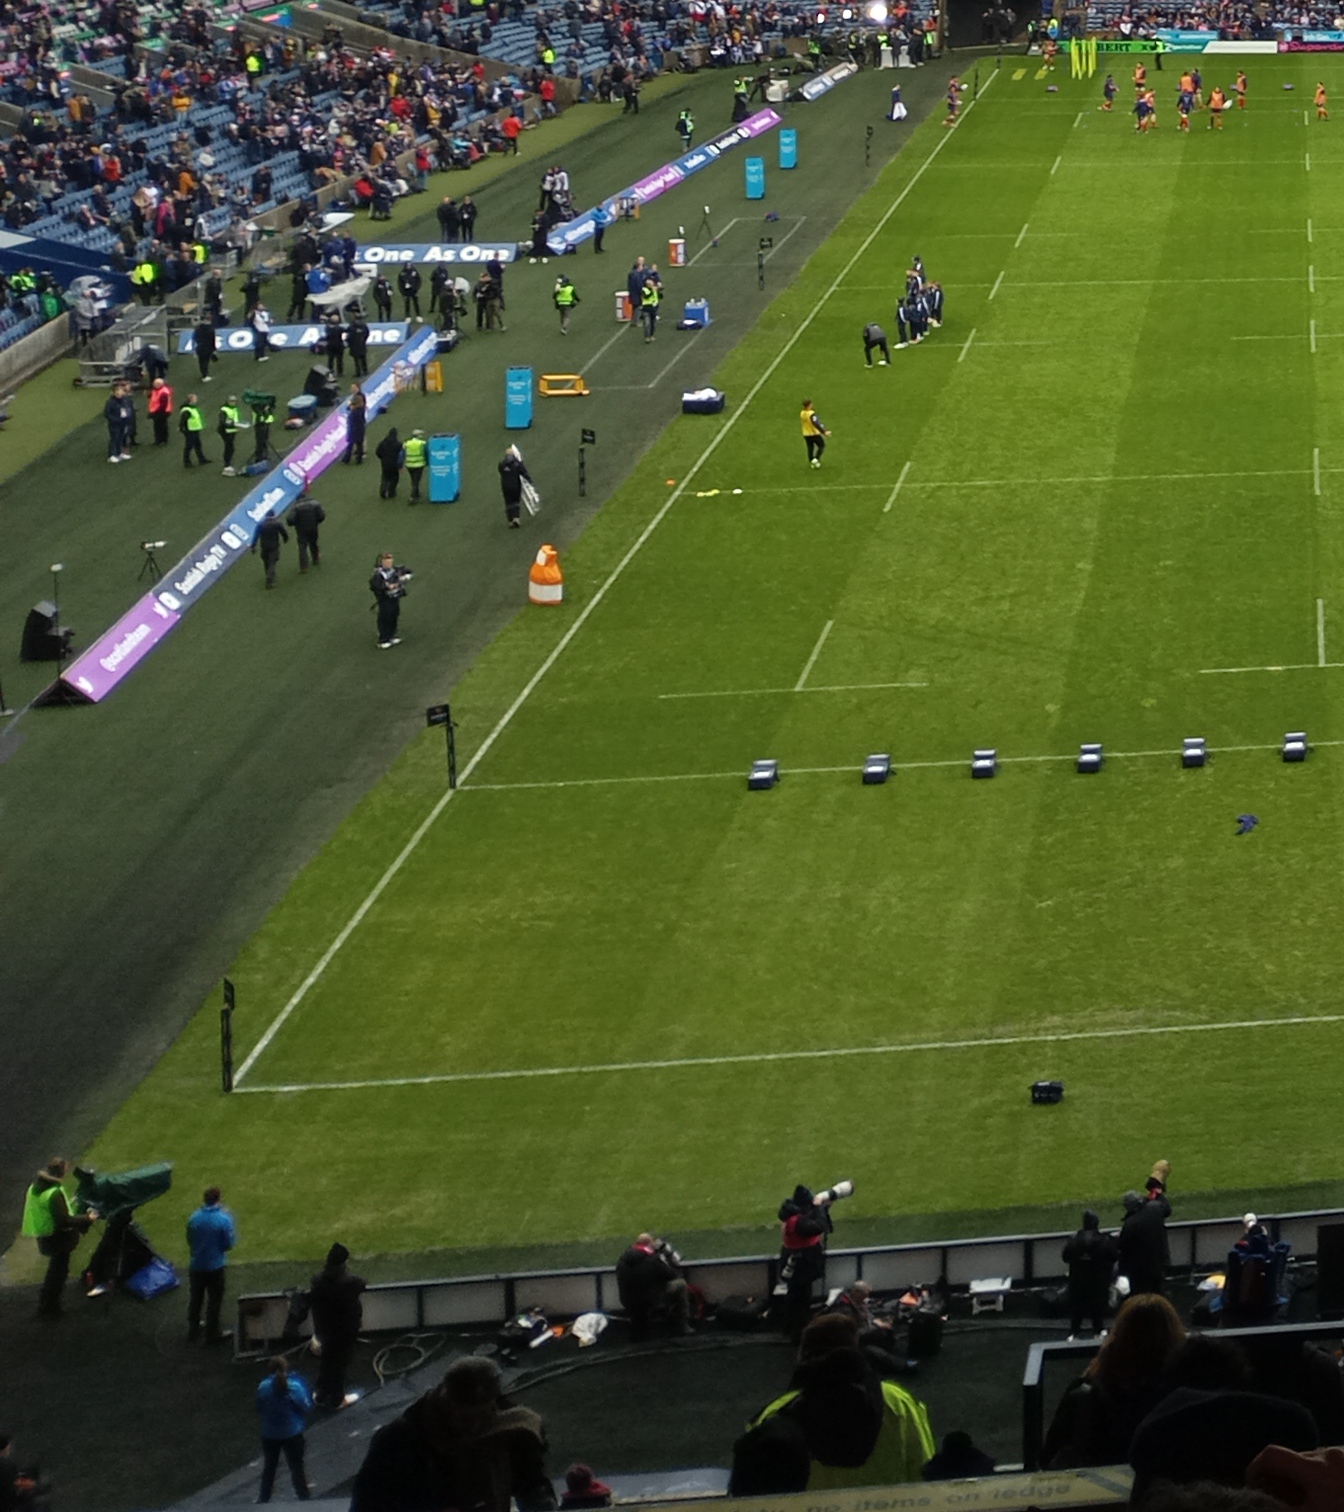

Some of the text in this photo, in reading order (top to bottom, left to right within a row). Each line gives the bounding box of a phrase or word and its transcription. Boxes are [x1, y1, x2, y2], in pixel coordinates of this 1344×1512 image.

[363, 245, 510, 262] One As One
[228, 330, 288, 348] Oe
[945, 1490, 980, 1503] on
